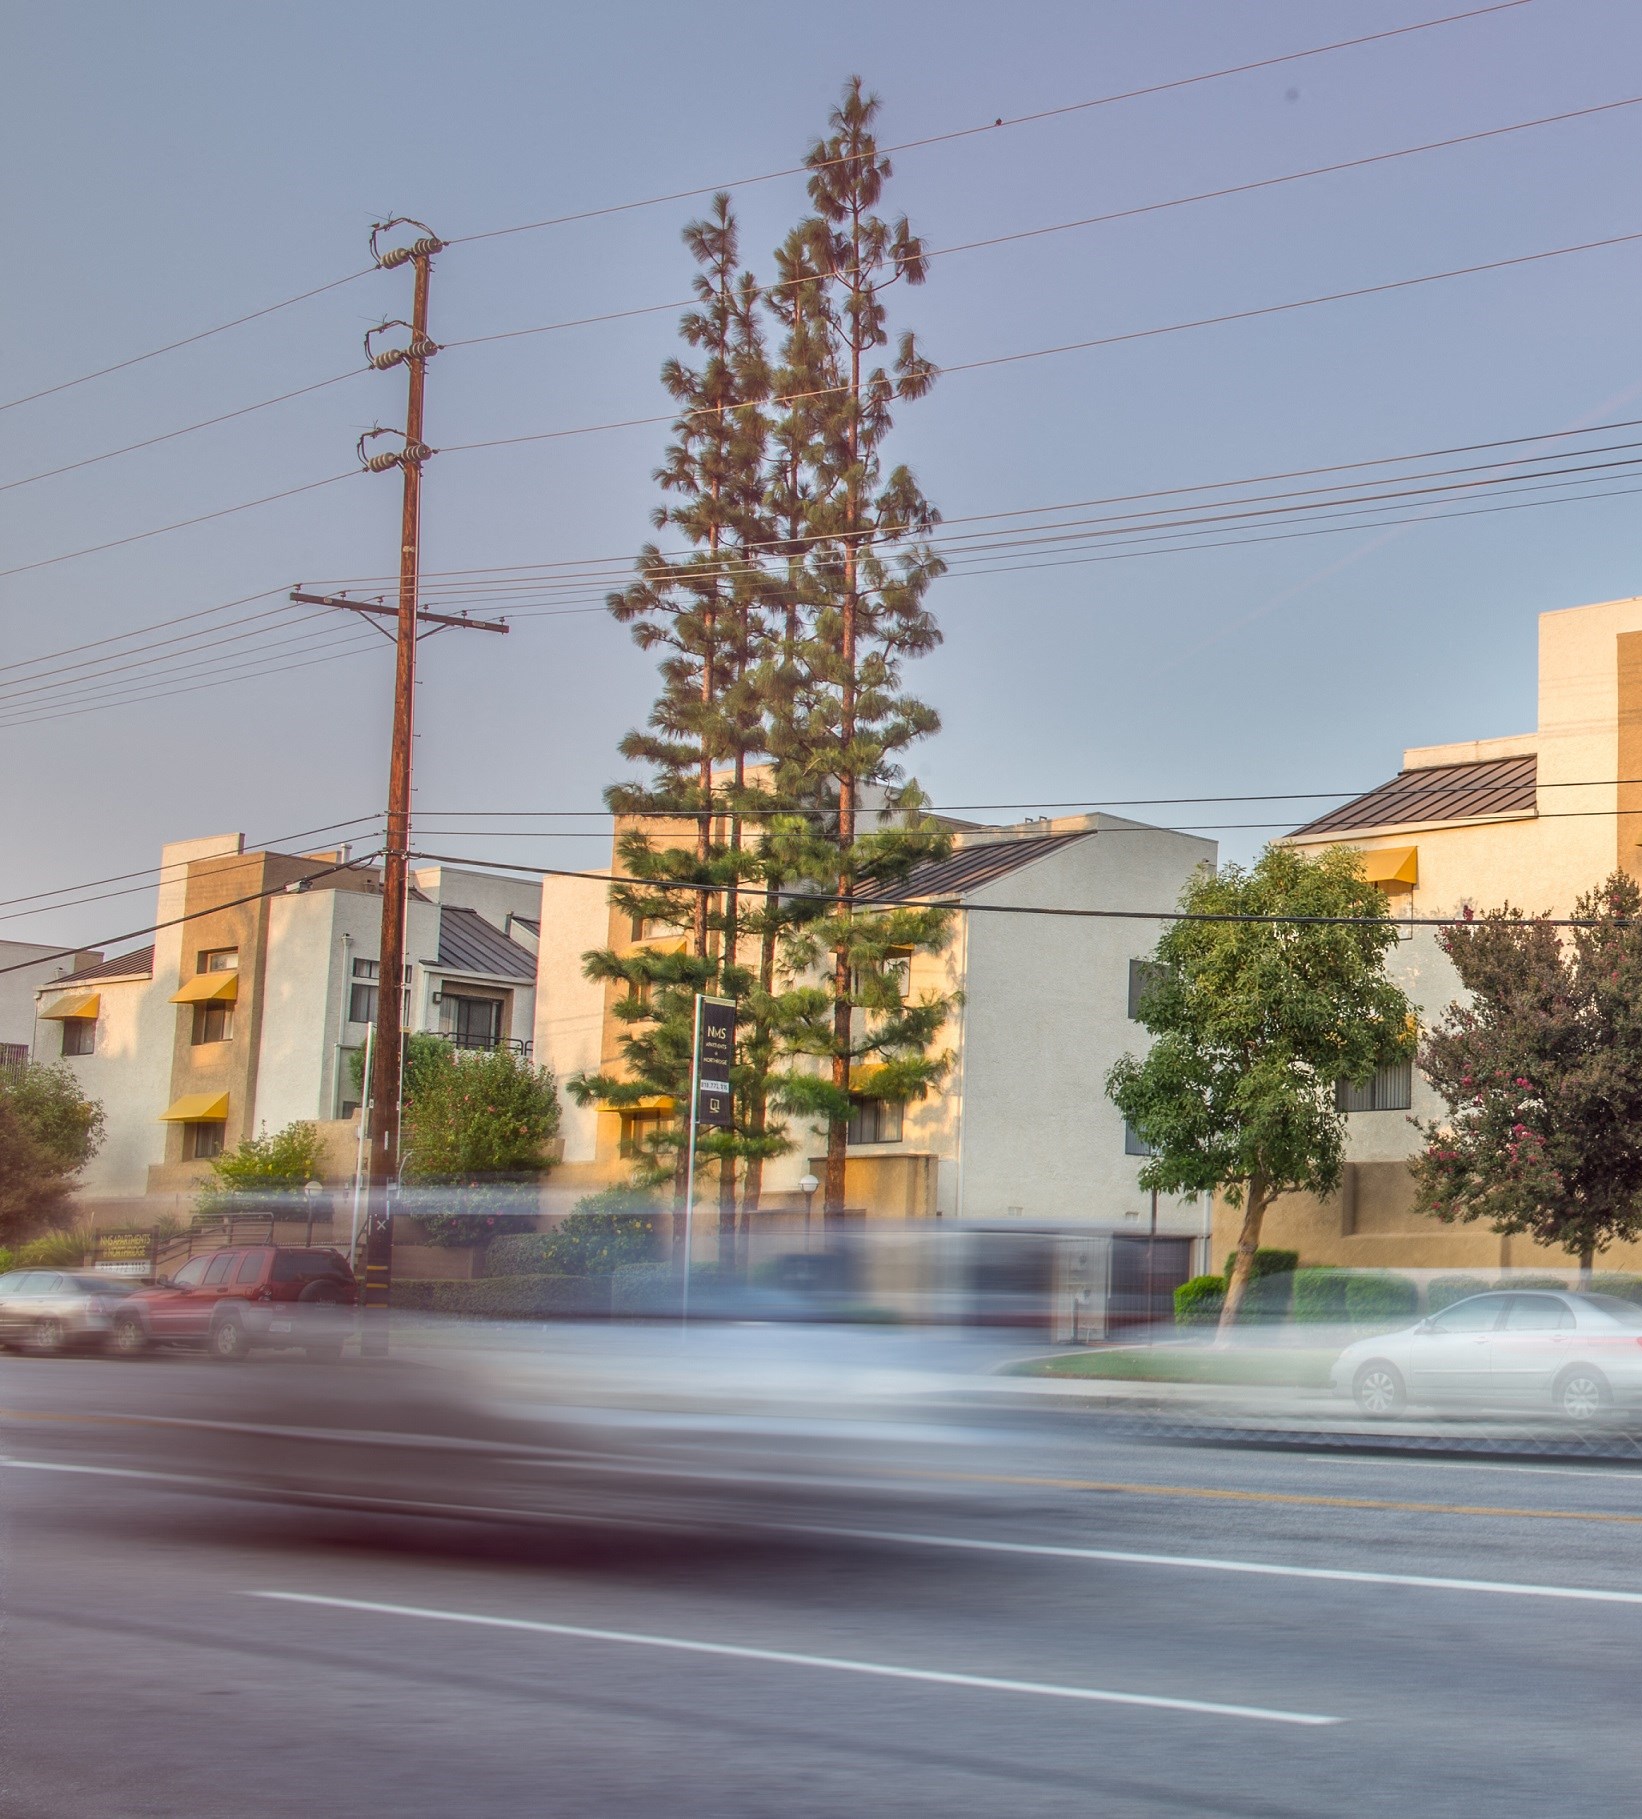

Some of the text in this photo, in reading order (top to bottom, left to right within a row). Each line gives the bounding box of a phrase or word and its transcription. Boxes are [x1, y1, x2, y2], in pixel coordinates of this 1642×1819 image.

[707, 1026, 726, 1040] NMS
[100, 1233, 151, 1246] NMS APARTMENTS
